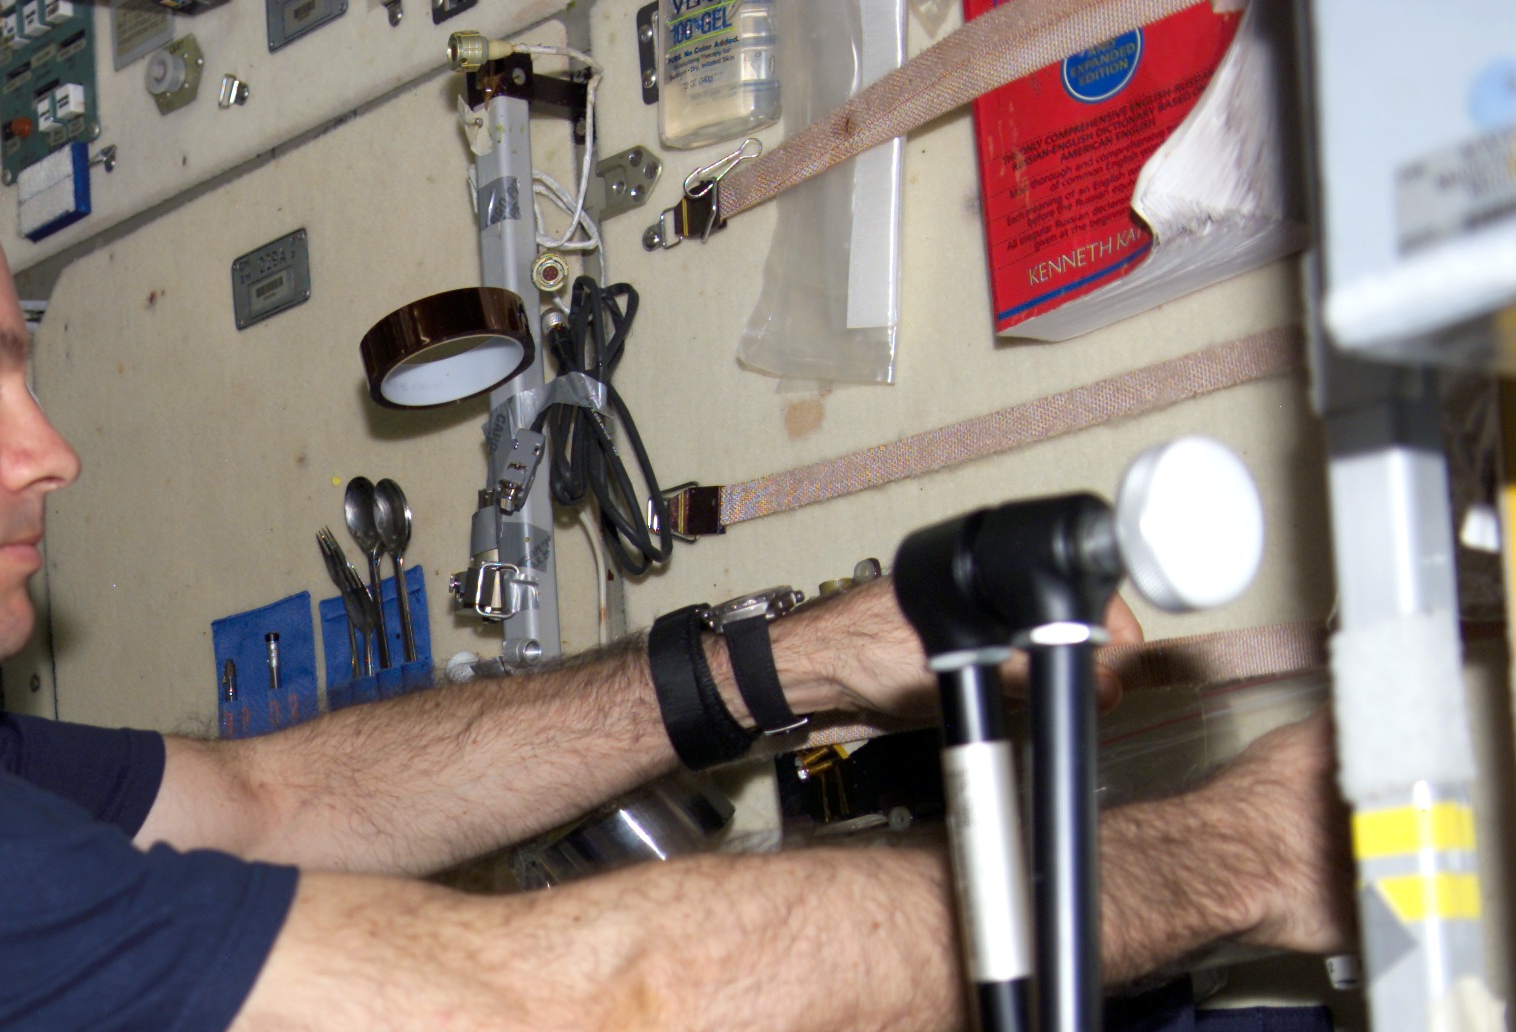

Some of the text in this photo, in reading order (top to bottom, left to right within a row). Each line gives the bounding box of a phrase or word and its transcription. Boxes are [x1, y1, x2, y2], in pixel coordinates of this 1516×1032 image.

[700, 7, 732, 34] GEL
[1071, 43, 1135, 77] EXPANDED
[1078, 60, 1129, 86] EDITION
[1042, 103, 1128, 149] COMPREHENSIVE
[1093, 104, 1156, 139] DICTIONARY
[1156, 90, 1192, 113] BASED
[1058, 132, 1115, 164] AMERICAN
[1113, 115, 1158, 142] ENGLISH
[1073, 156, 1095, 172] and
[1028, 237, 1113, 286] KENNETH
